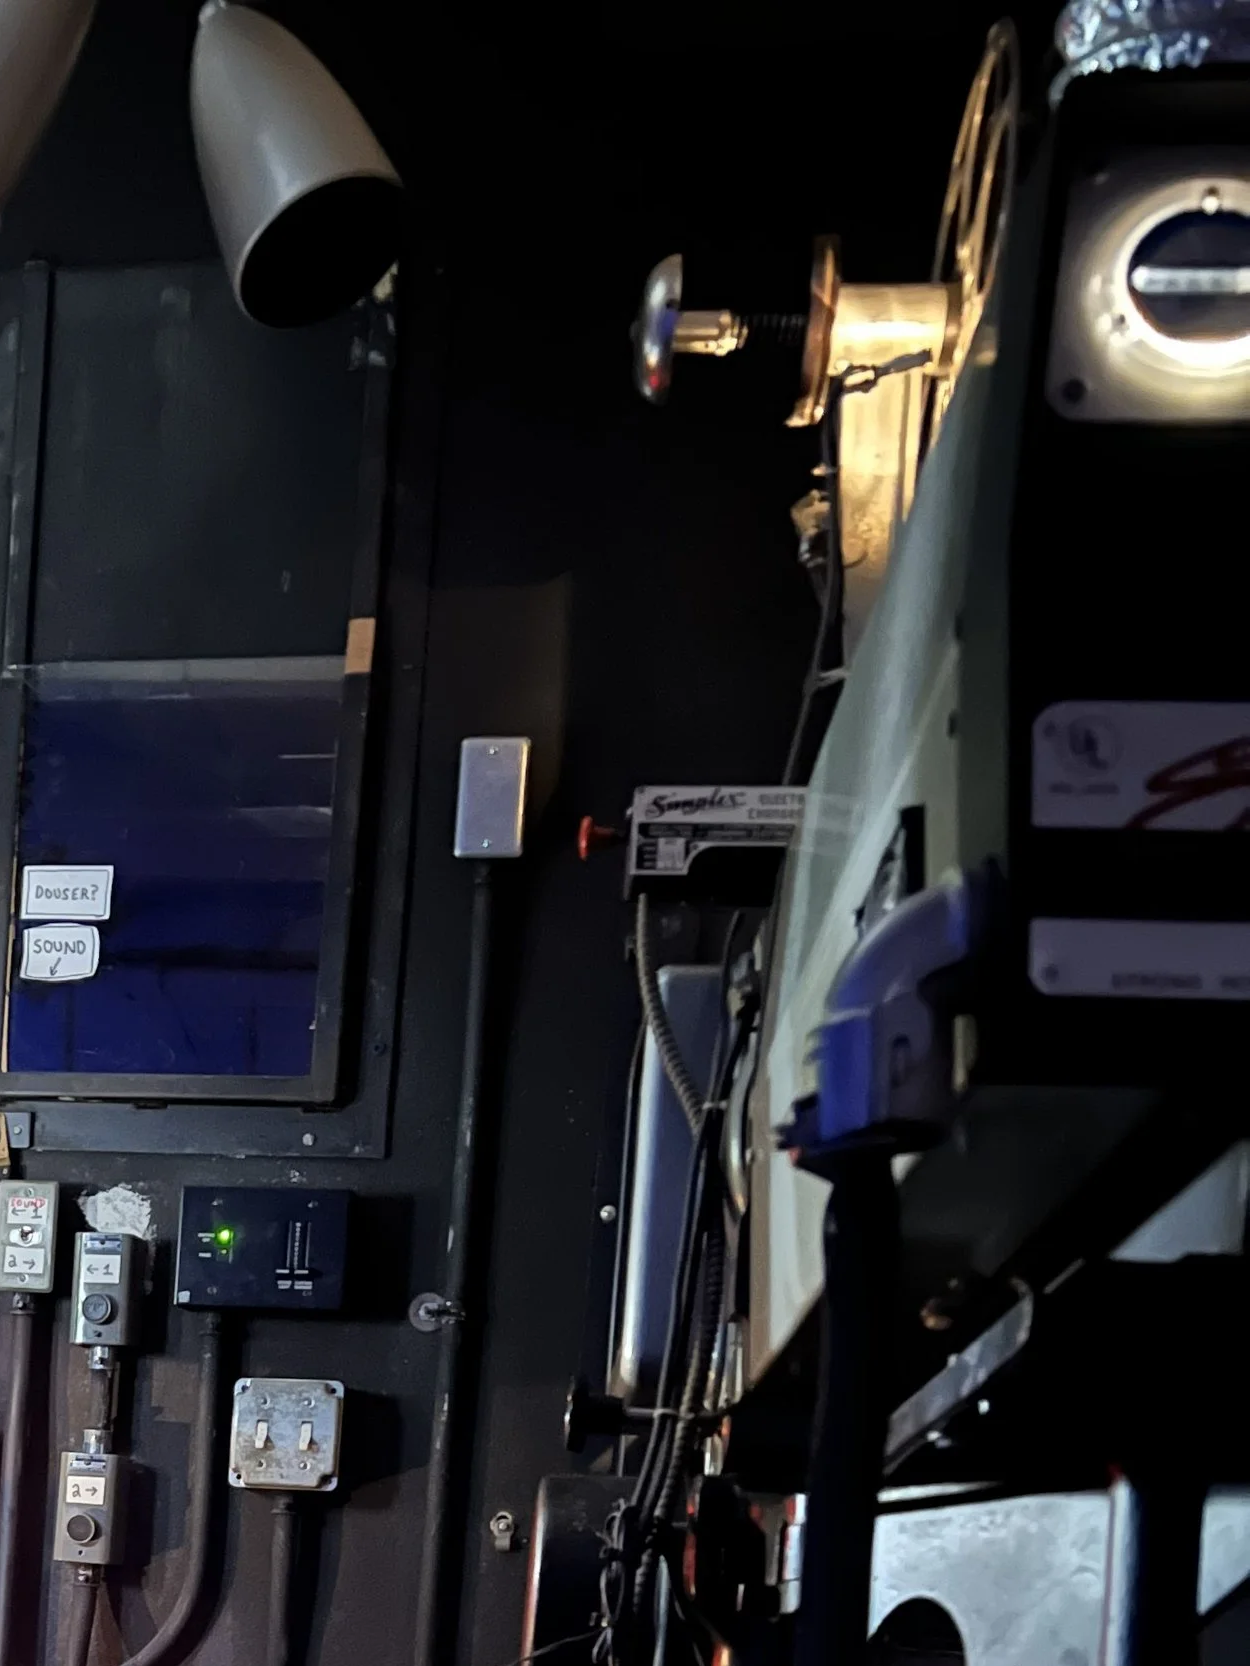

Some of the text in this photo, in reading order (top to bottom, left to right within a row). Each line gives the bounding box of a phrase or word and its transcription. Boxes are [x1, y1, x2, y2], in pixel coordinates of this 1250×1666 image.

[34, 884, 99, 901] DOUSER?
[33, 938, 87, 955] SOUND
[11, 1197, 46, 1209] SOUND
[30, 1207, 43, 1219] 1
[102, 1264, 113, 1275] 1
